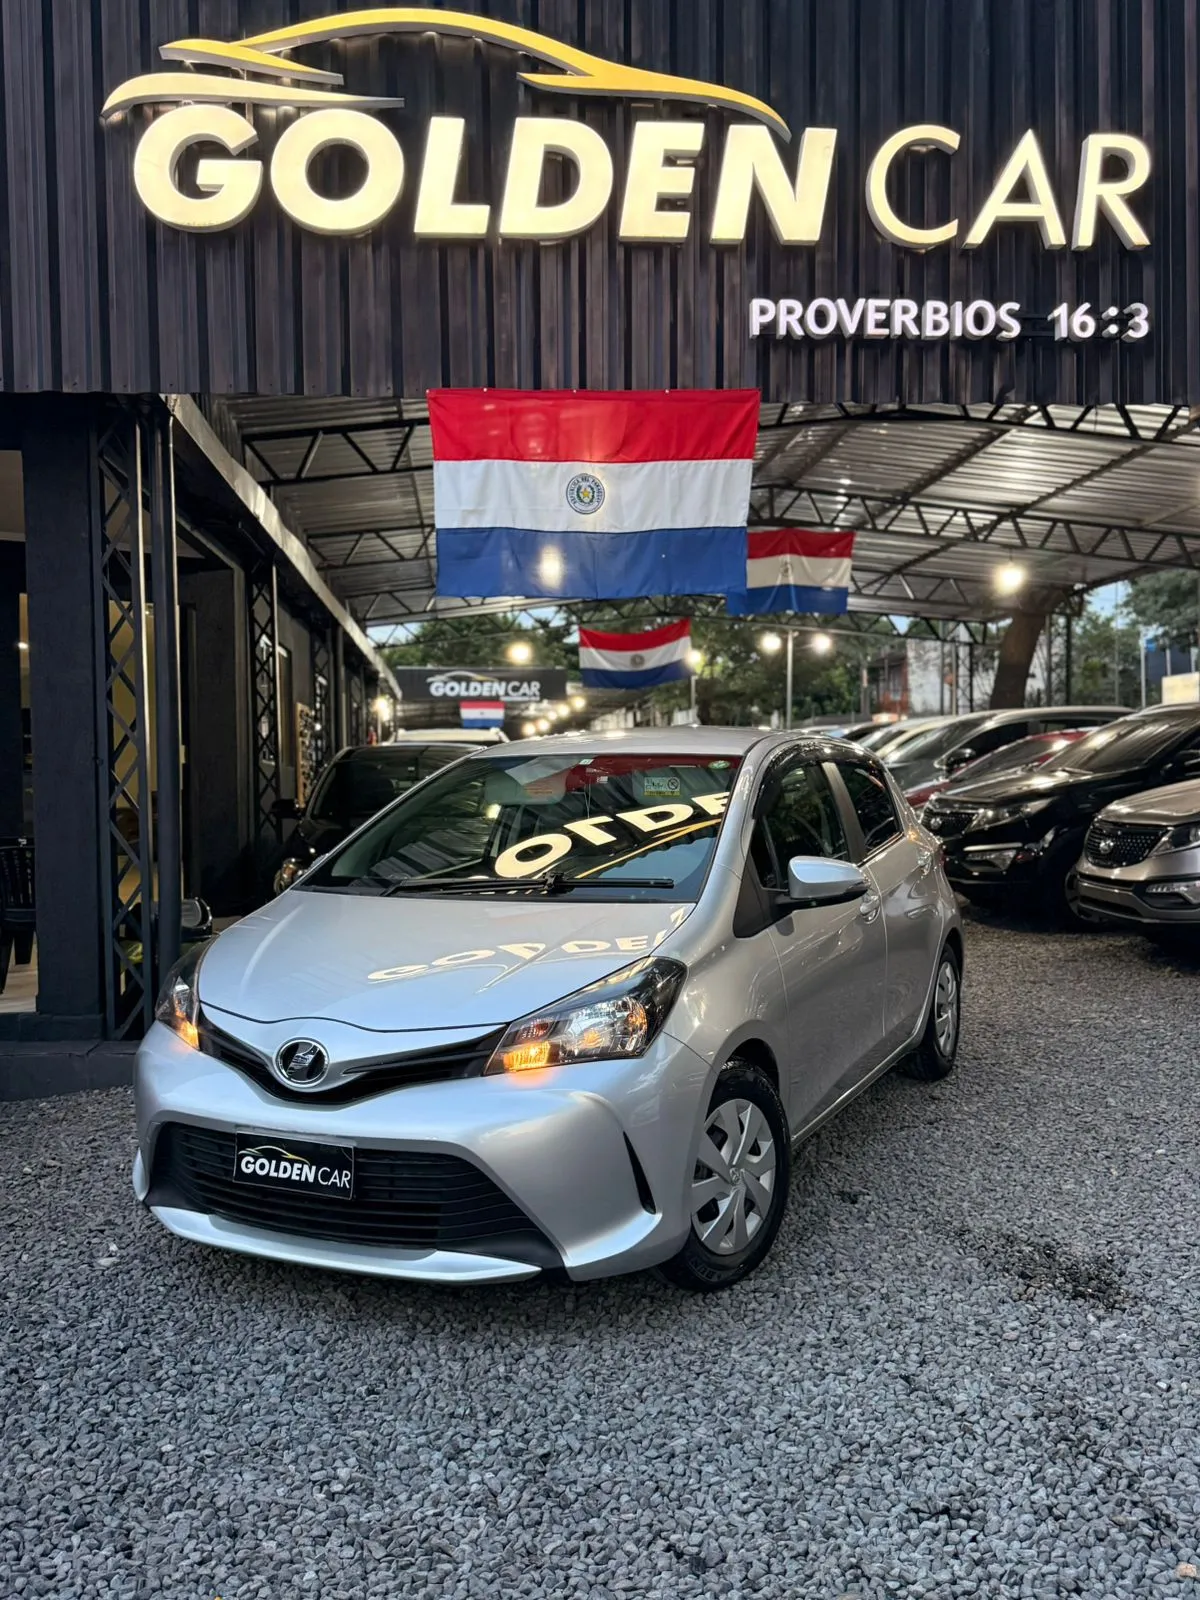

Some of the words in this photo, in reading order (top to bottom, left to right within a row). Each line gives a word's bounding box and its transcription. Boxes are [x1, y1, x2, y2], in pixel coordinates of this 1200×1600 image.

[133, 103, 838, 245] GOLDEN
[865, 124, 1153, 251] CAR
[749, 297, 1022, 341] PROVERBIOS
[1047, 301, 1150, 342] 16:3
[429, 680, 507, 697] GOLDEN
[506, 680, 541, 697] CAR
[240, 1156, 317, 1183] GOLDEN
[317, 1167, 352, 1189] CAR
